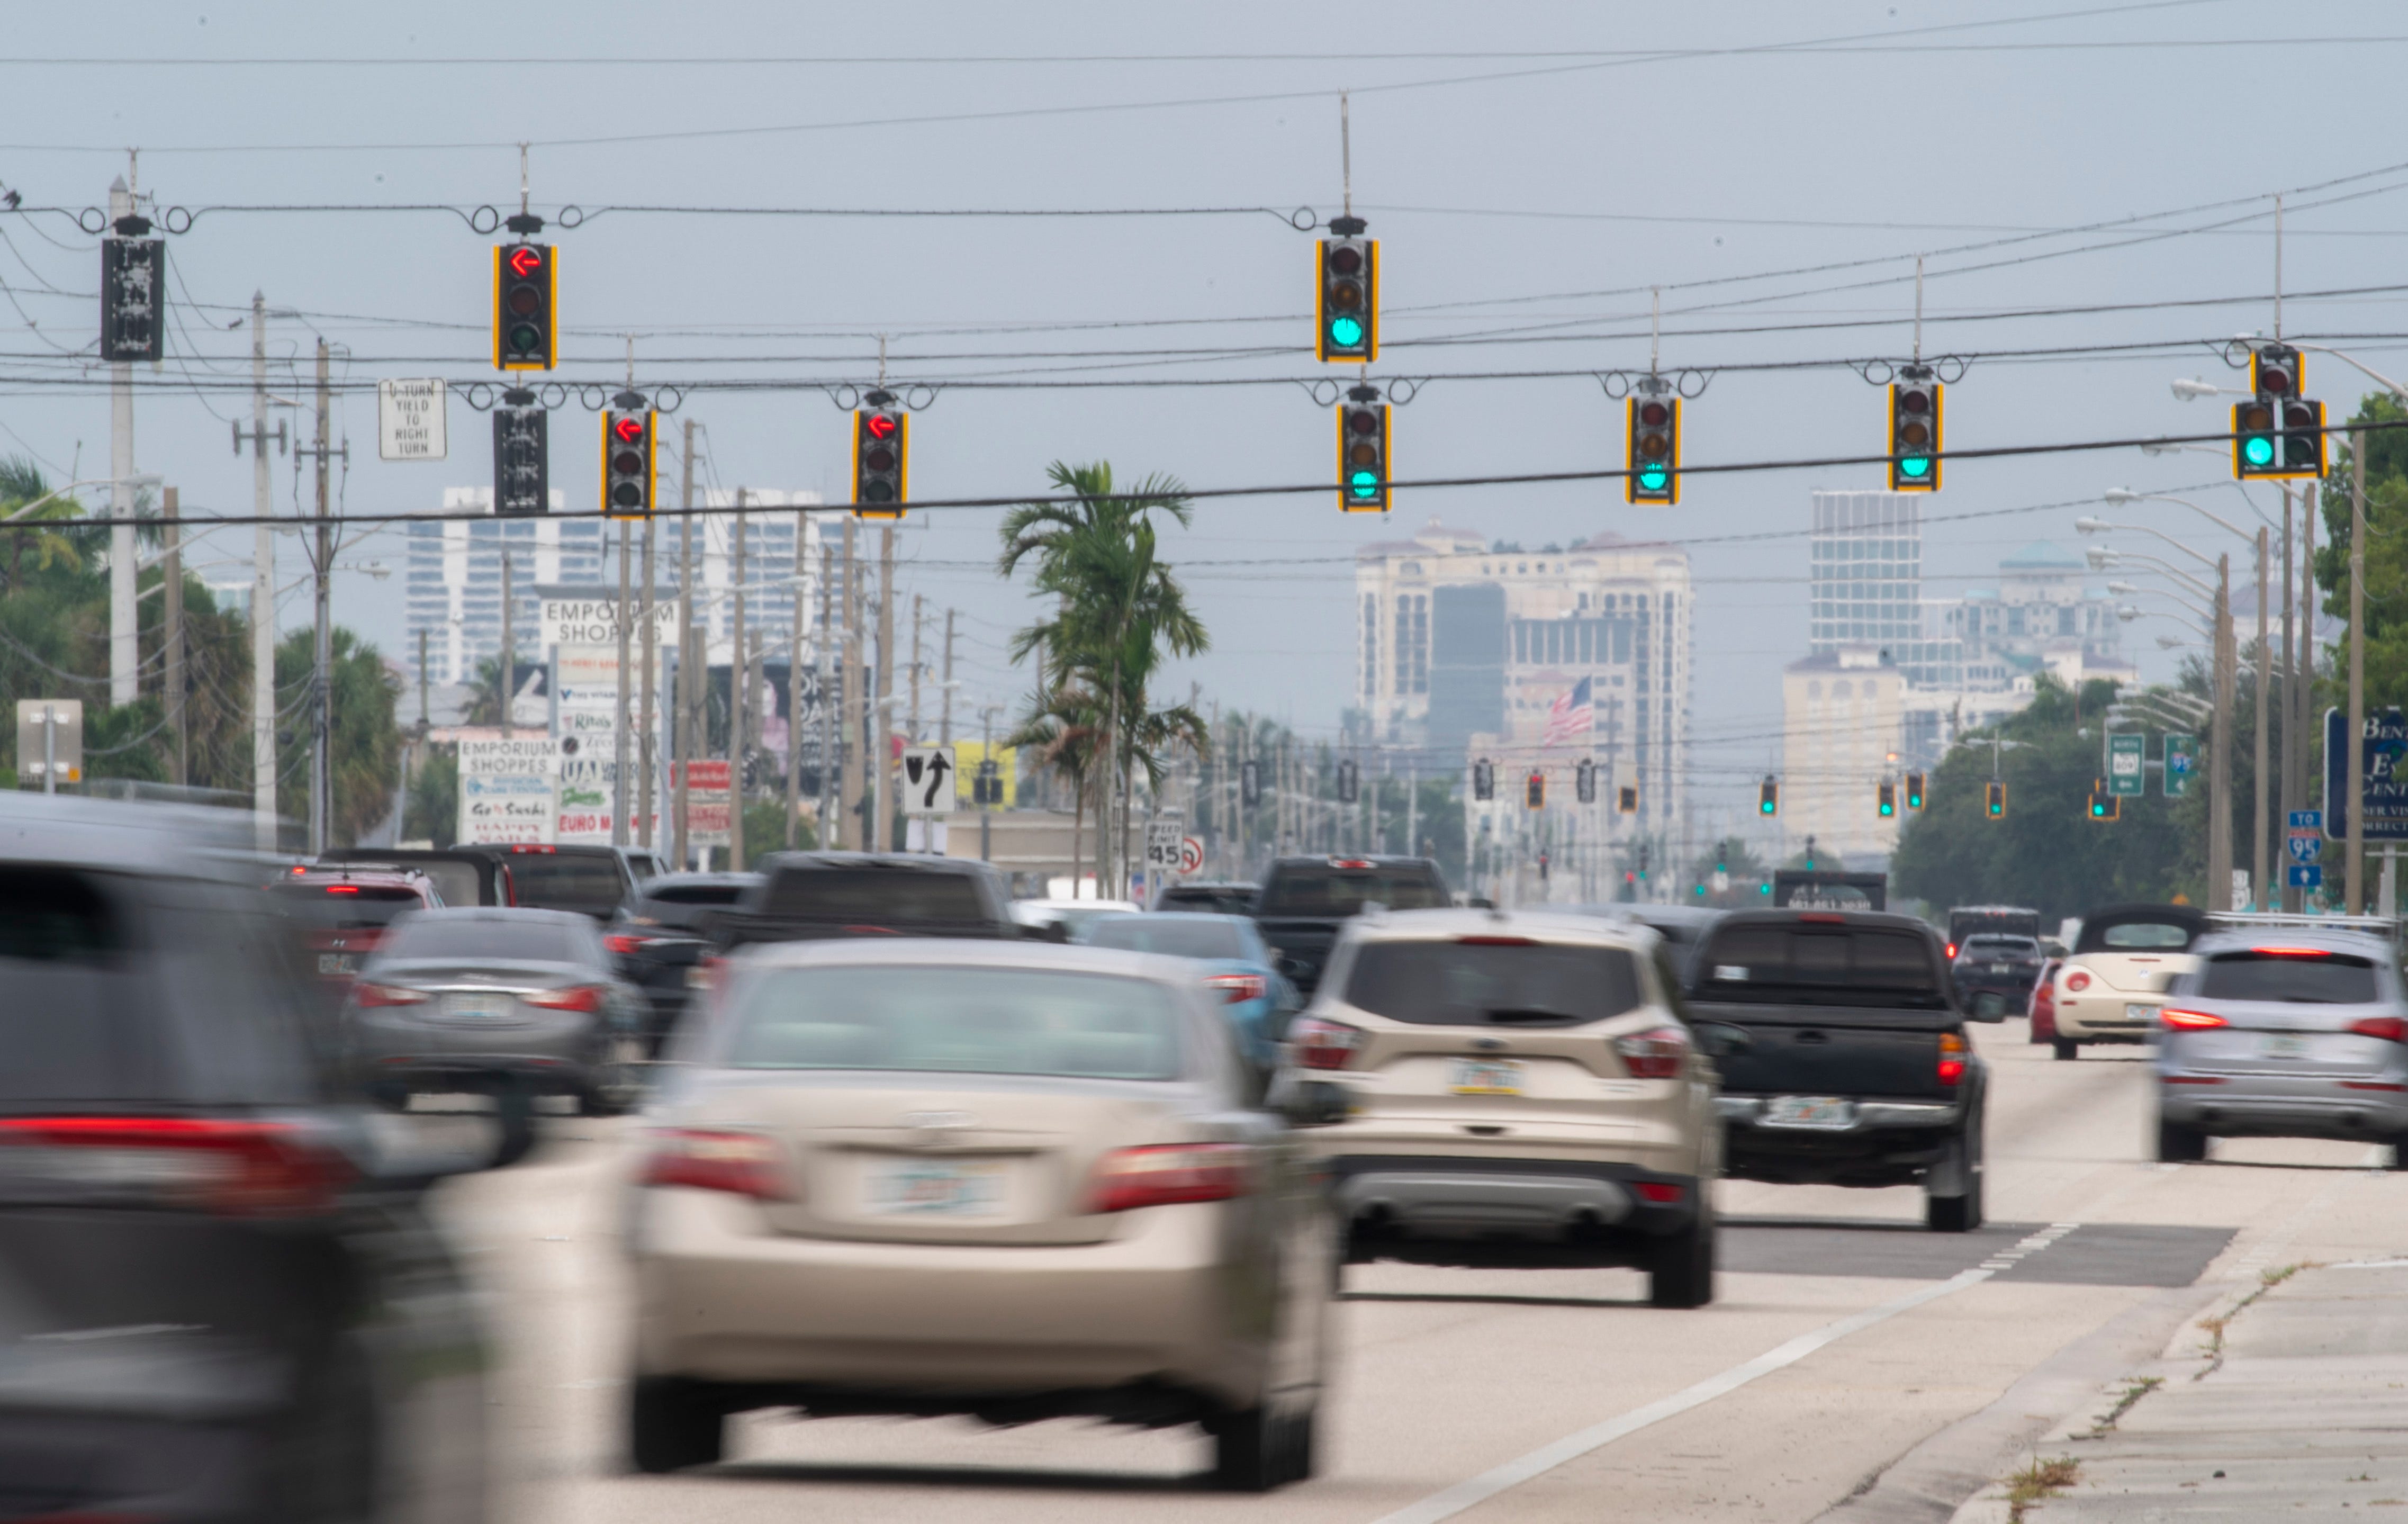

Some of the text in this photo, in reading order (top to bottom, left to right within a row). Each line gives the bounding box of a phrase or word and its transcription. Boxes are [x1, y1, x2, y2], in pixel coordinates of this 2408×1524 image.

[396, 400, 429, 411] YIELD
[407, 414, 419, 425] TO
[395, 428, 428, 439] RIGHT
[399, 443, 428, 454] TURN
[559, 624, 662, 642] SHOPES
[463, 742, 556, 756] EMPORIUM
[470, 759, 547, 772] SHOPPES
[506, 802, 546, 816] Sushi
[559, 814, 596, 832] EURO
[2297, 814, 2314, 825] TO
[1148, 846, 1179, 864] 45
[2293, 839, 2316, 860] 95
